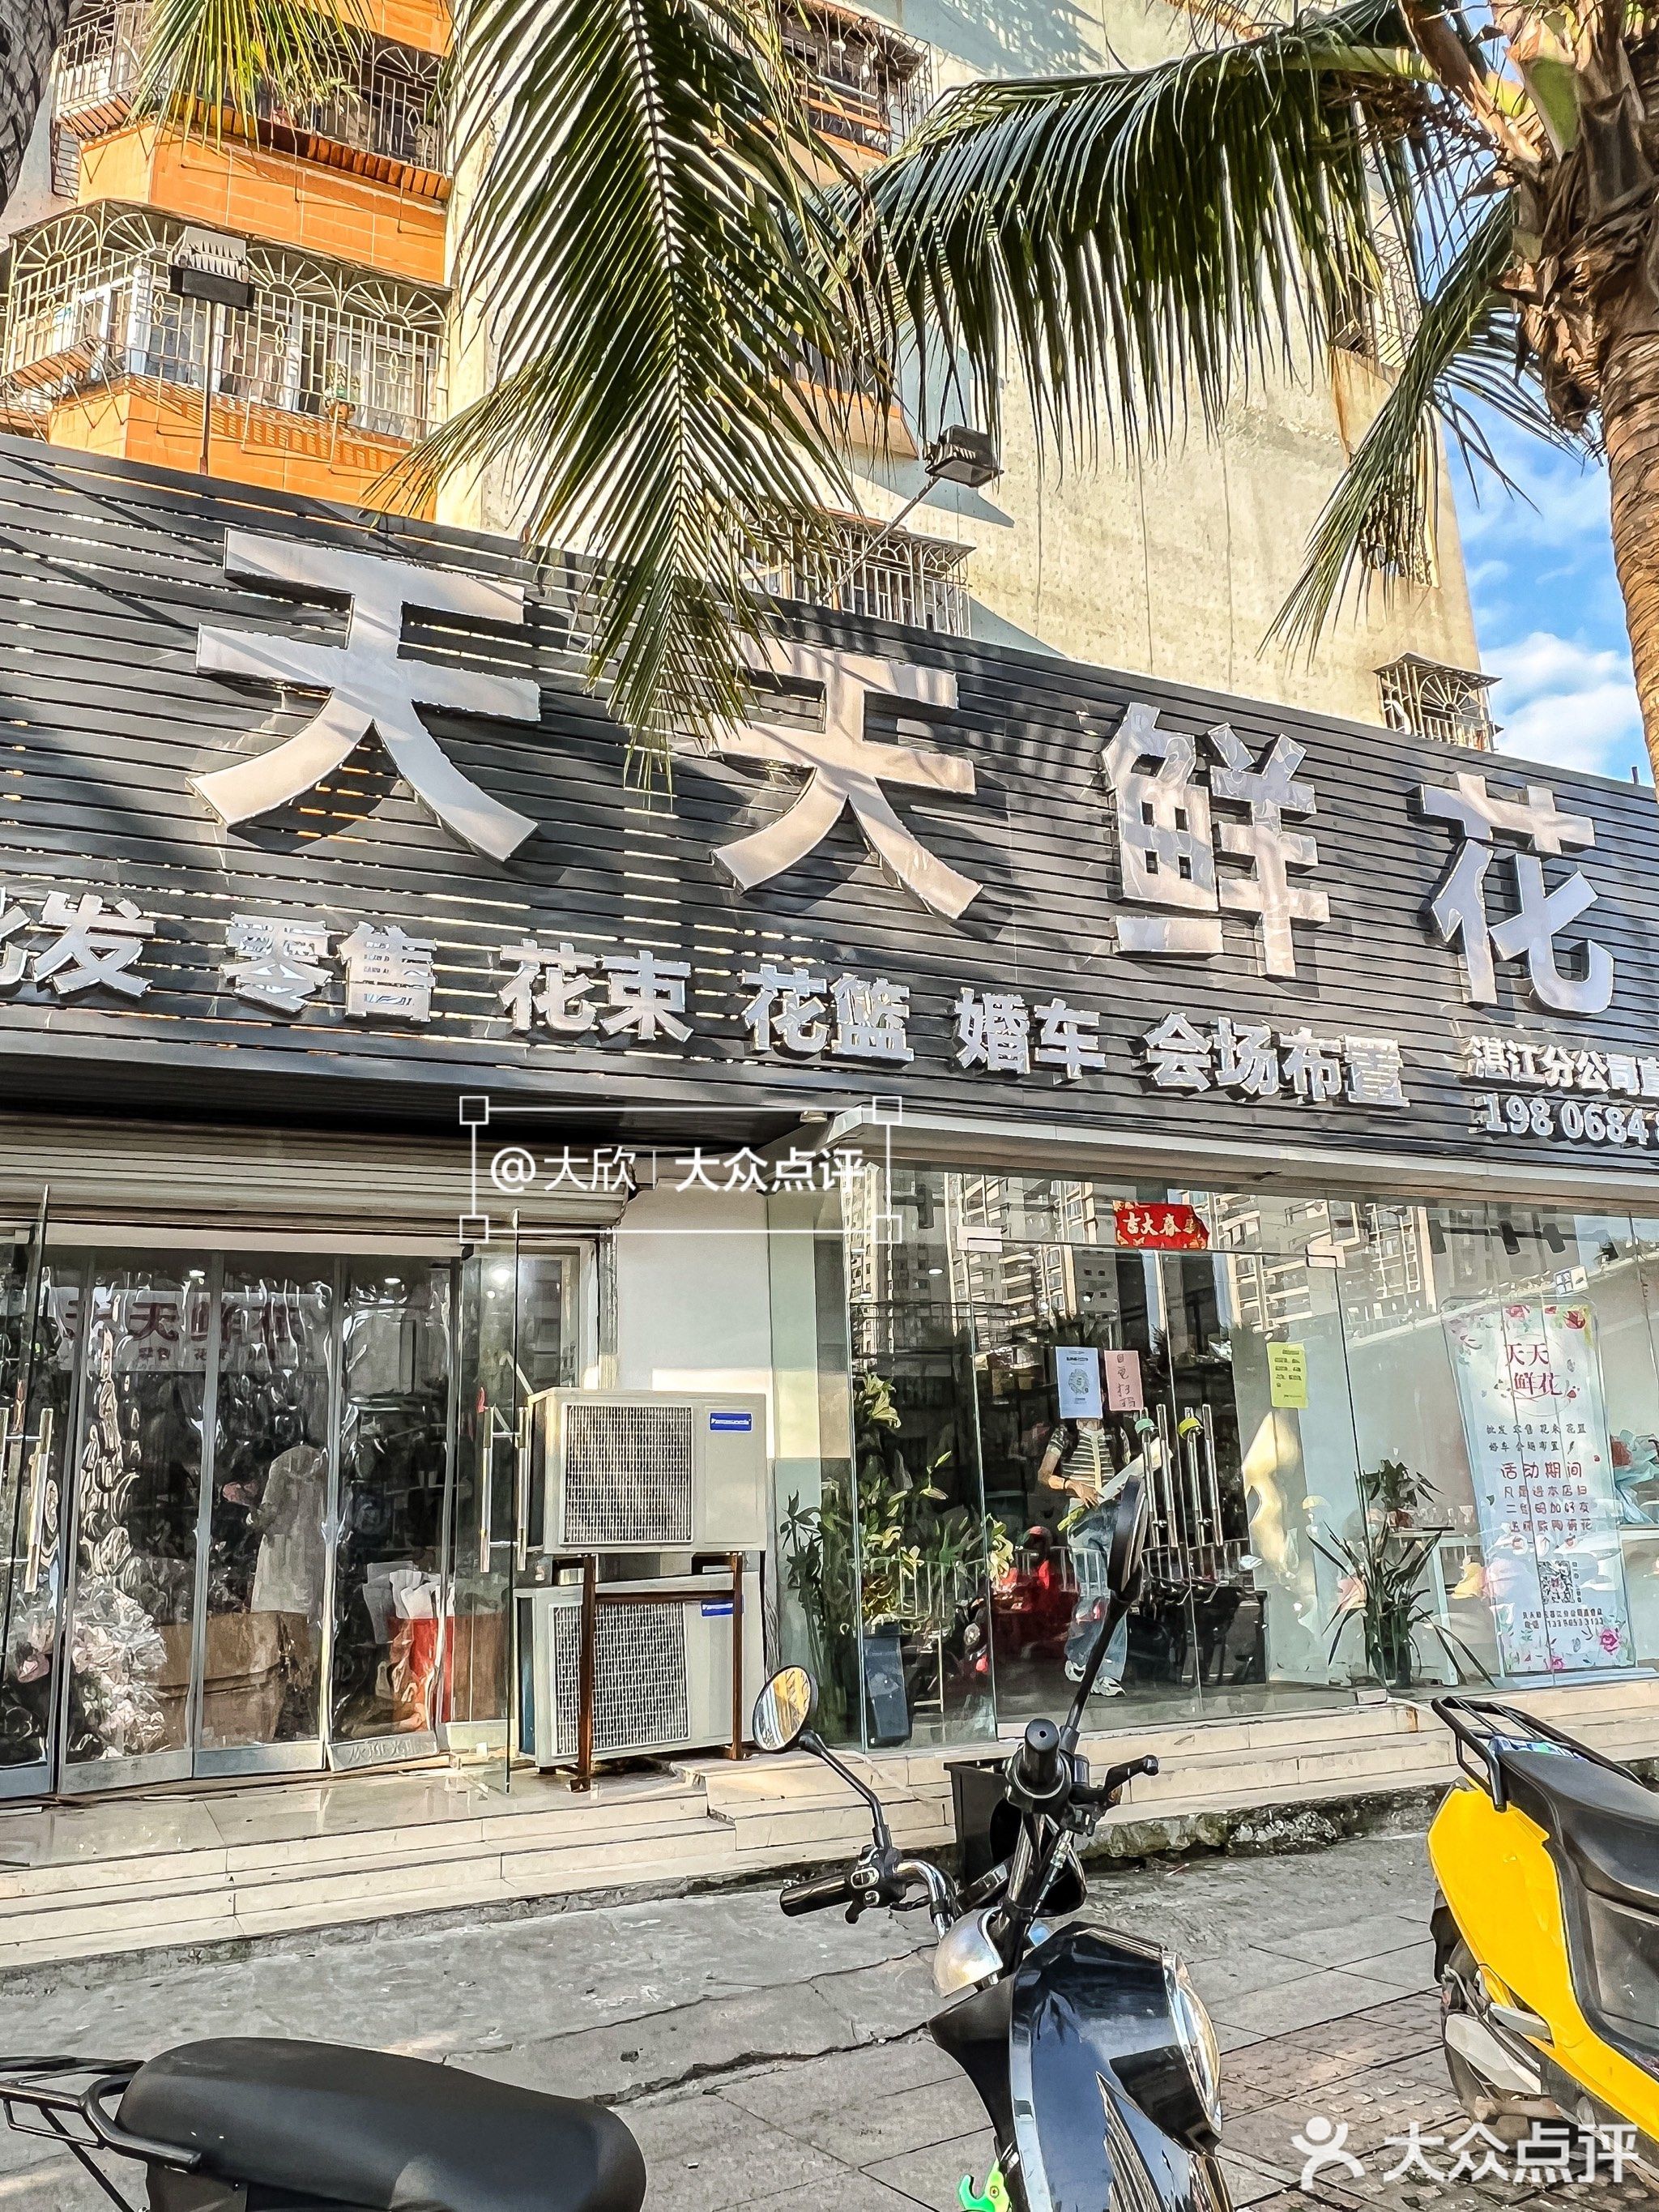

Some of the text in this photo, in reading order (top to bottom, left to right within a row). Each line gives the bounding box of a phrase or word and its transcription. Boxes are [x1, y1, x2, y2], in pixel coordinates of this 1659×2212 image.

[186, 527, 1614, 1014] 天天鲜花
[221, 912, 437, 1023] 零售
[499, 937, 694, 1044] 花束
[739, 963, 915, 1062] 花篮
[954, 986, 1107, 1084] 婚车
[1137, 1011, 1410, 1108] 会场布置
[1560, 1100, 1659, 1146] 0684
